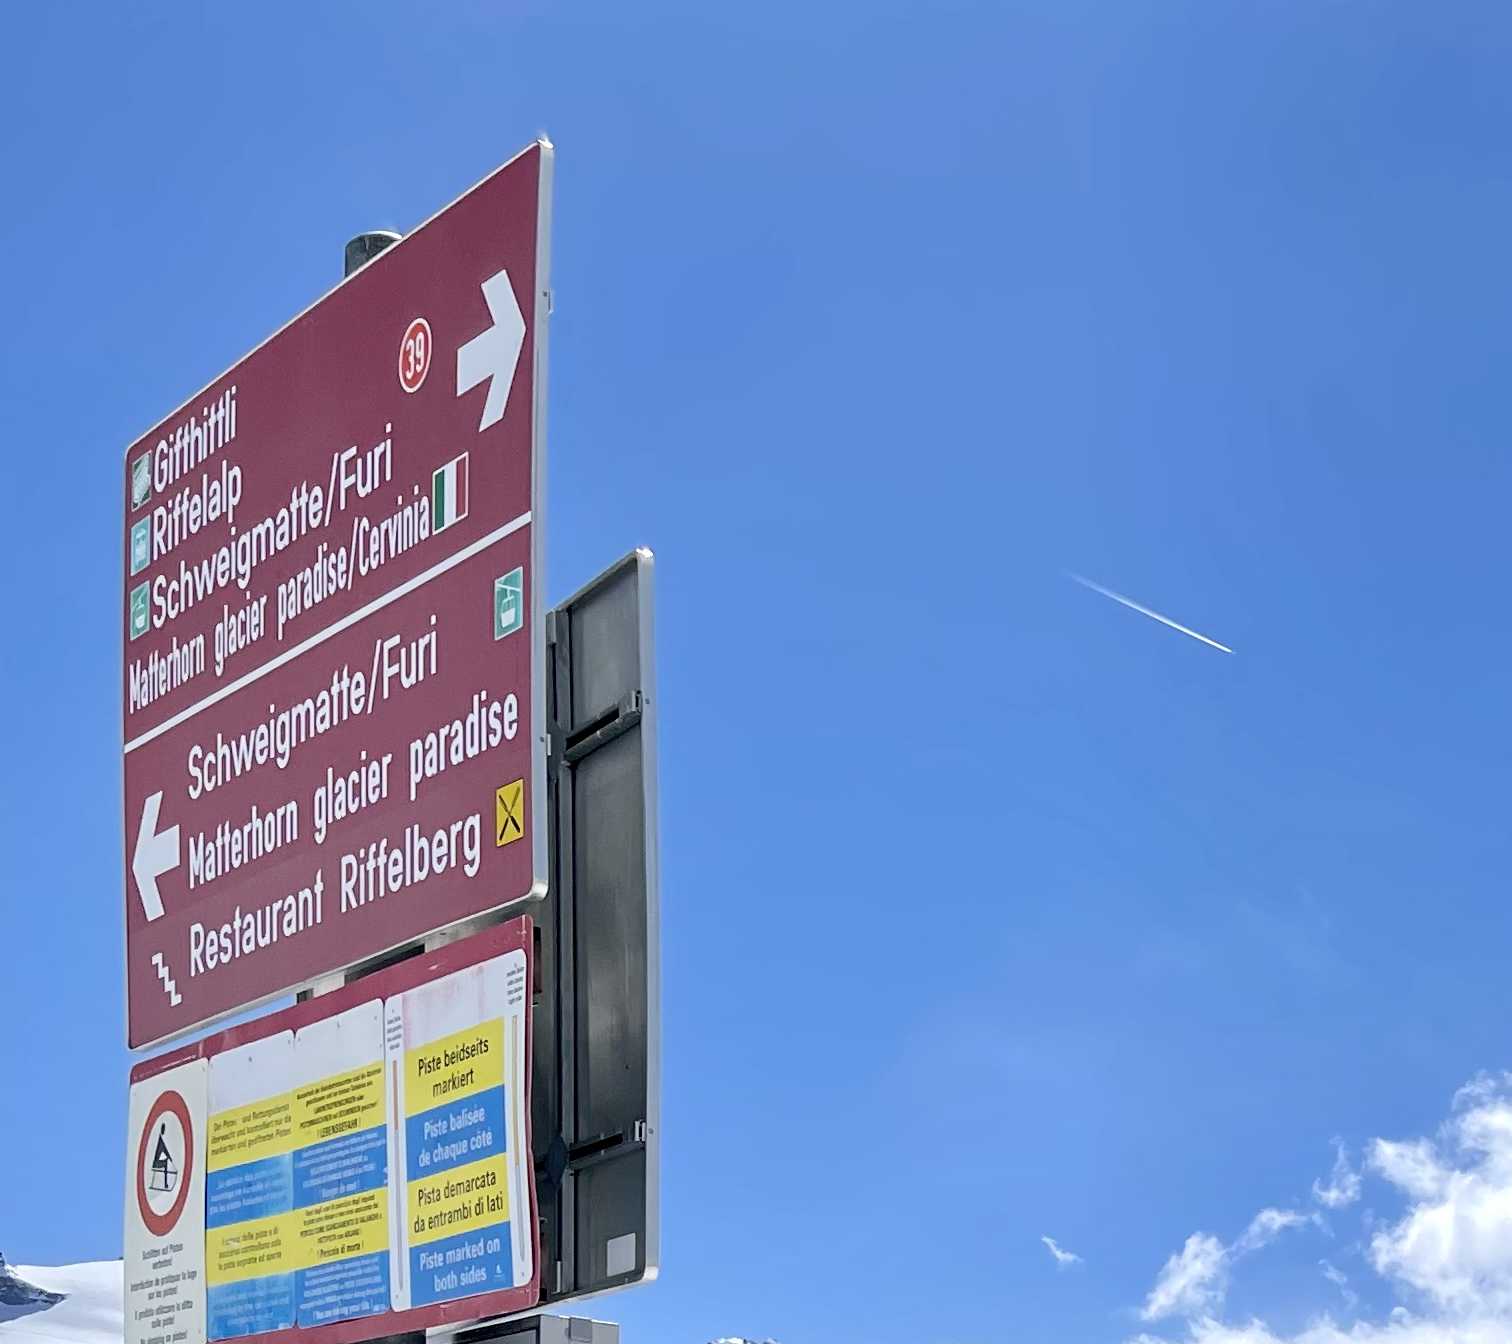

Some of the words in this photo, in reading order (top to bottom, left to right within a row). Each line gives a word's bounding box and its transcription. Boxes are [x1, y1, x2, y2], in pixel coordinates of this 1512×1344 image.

[404, 332, 425, 379] 39
[153, 385, 237, 493] Gifthittli
[152, 459, 242, 561] Riffelalp
[152, 422, 392, 629] Schweigmatte/Furi
[129, 633, 205, 715] Matterhorn
[214, 590, 267, 677] glacier
[277, 485, 430, 641] paradise/Cervinia
[188, 614, 438, 800] Schweigmatte/Furi
[188, 800, 299, 890] Matterhorn
[313, 750, 392, 845] glacier
[409, 690, 519, 801] paradise
[189, 868, 324, 977] Restaurant
[340, 813, 481, 914] Riffelberg
[418, 1055, 442, 1077] Piste
[443, 1037, 489, 1068] beidseits
[432, 1067, 475, 1098] markiert
[423, 1116, 448, 1141] Piste
[418, 1147, 431, 1168] de
[432, 1140, 468, 1164] chaque
[413, 1214, 426, 1234] da
[428, 1198, 472, 1231] entrambi
[474, 1195, 485, 1216] di
[486, 1189, 504, 1214] lati
[418, 1187, 441, 1208] Pista
[443, 1170, 497, 1199] demarcata
[419, 1250, 444, 1272] Piste
[445, 1236, 485, 1265] marked
[486, 1237, 501, 1254] on
[433, 1270, 458, 1293] both
[459, 1263, 488, 1287] sides
